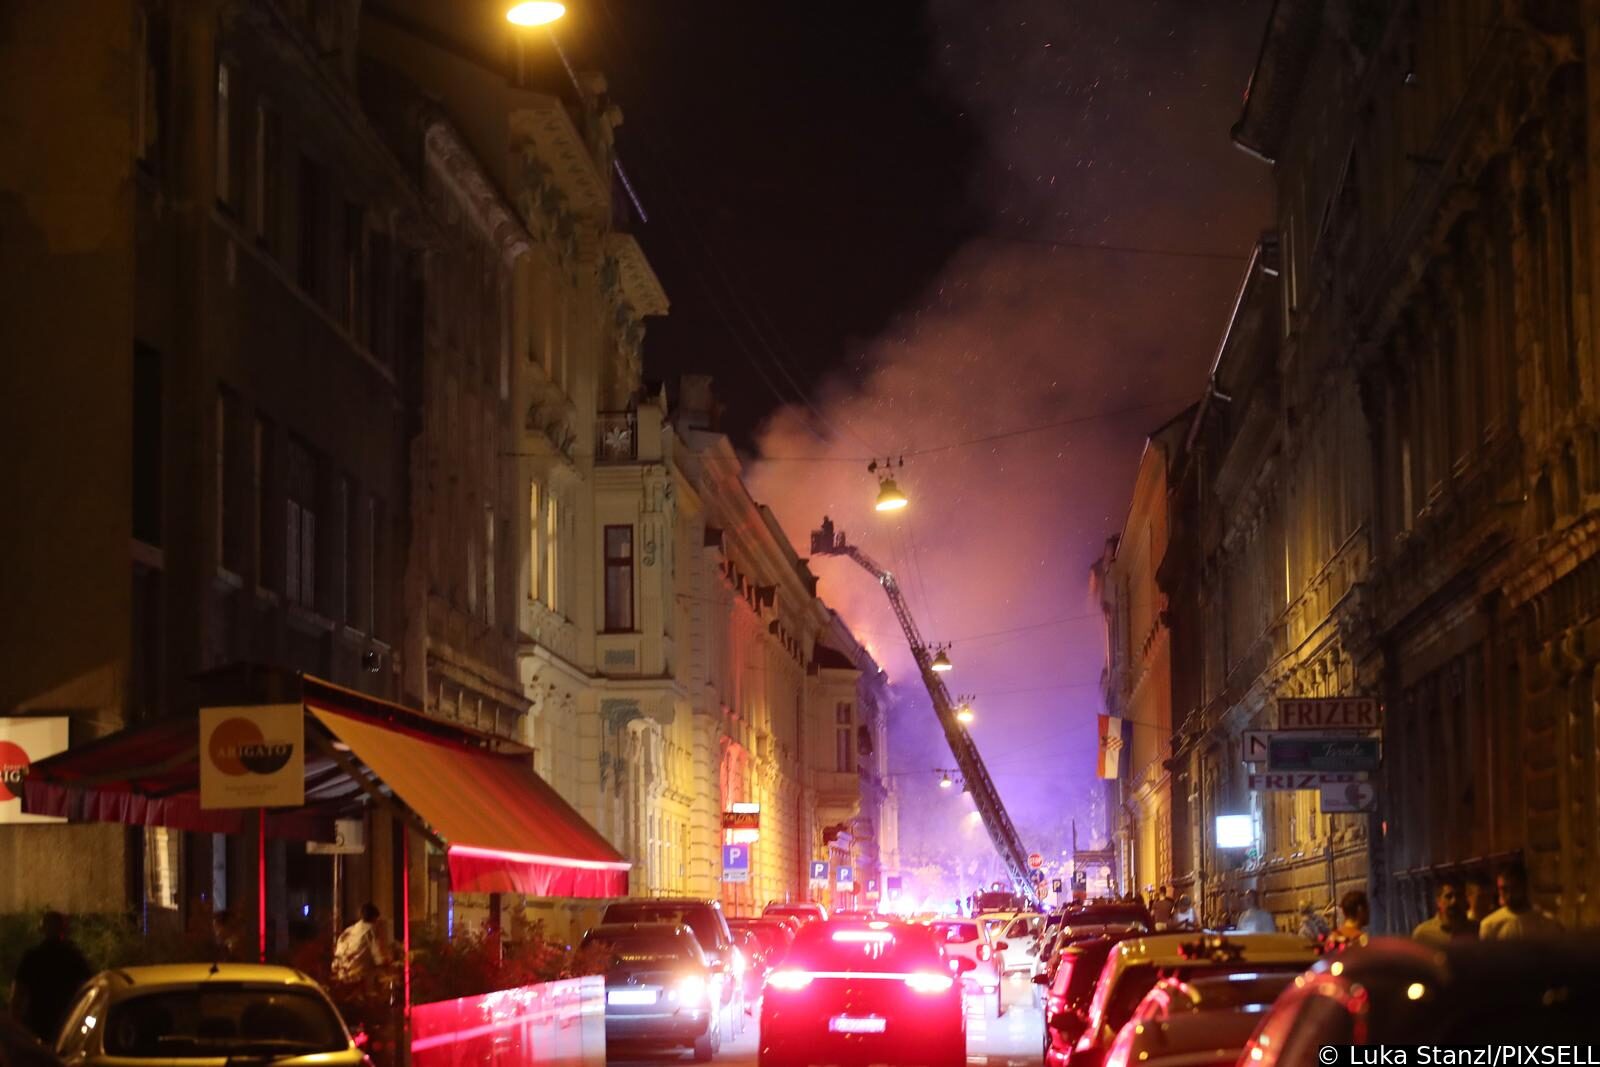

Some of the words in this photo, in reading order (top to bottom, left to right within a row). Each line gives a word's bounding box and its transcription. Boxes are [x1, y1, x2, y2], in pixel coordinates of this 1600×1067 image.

[1284, 703, 1373, 725] FRIZER
[217, 744, 287, 758] ARIGATO
[730, 849, 741, 865] P
[814, 863, 824, 878] P
[840, 868, 849, 881] P
[1076, 872, 1083, 882] P
[868, 880, 875, 891] P
[1054, 882, 1061, 891] P
